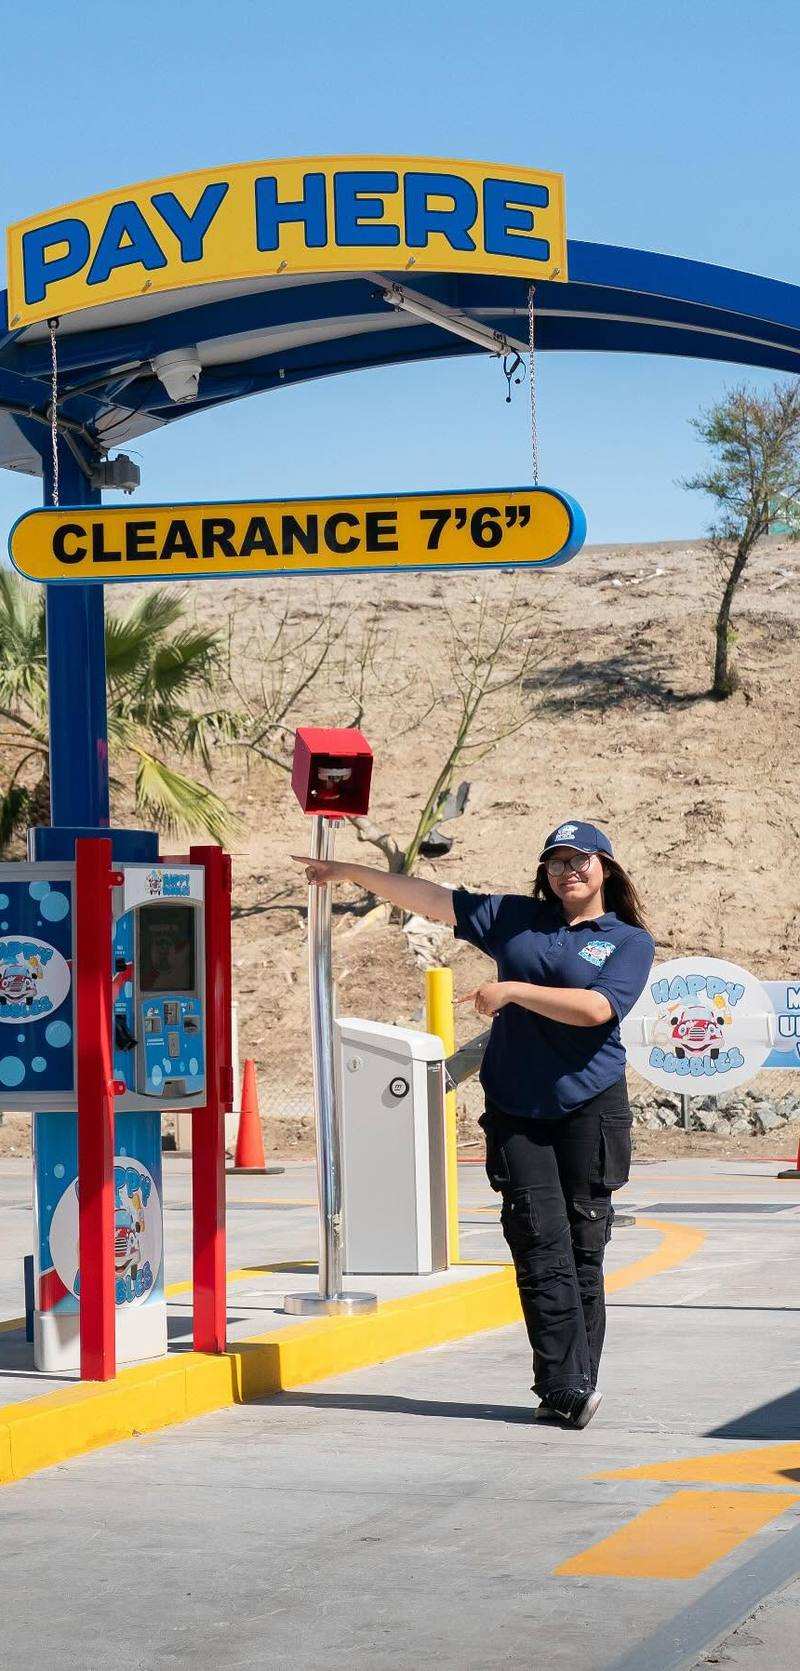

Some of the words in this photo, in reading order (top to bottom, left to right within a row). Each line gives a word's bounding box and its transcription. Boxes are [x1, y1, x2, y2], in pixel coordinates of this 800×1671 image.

[22, 182, 229, 305] PAY
[254, 170, 550, 262] HERE
[52, 511, 399, 564] CLEARANCE
[651, 975, 745, 1006] HAPPY
[649, 1047, 745, 1077] BUBBLES
